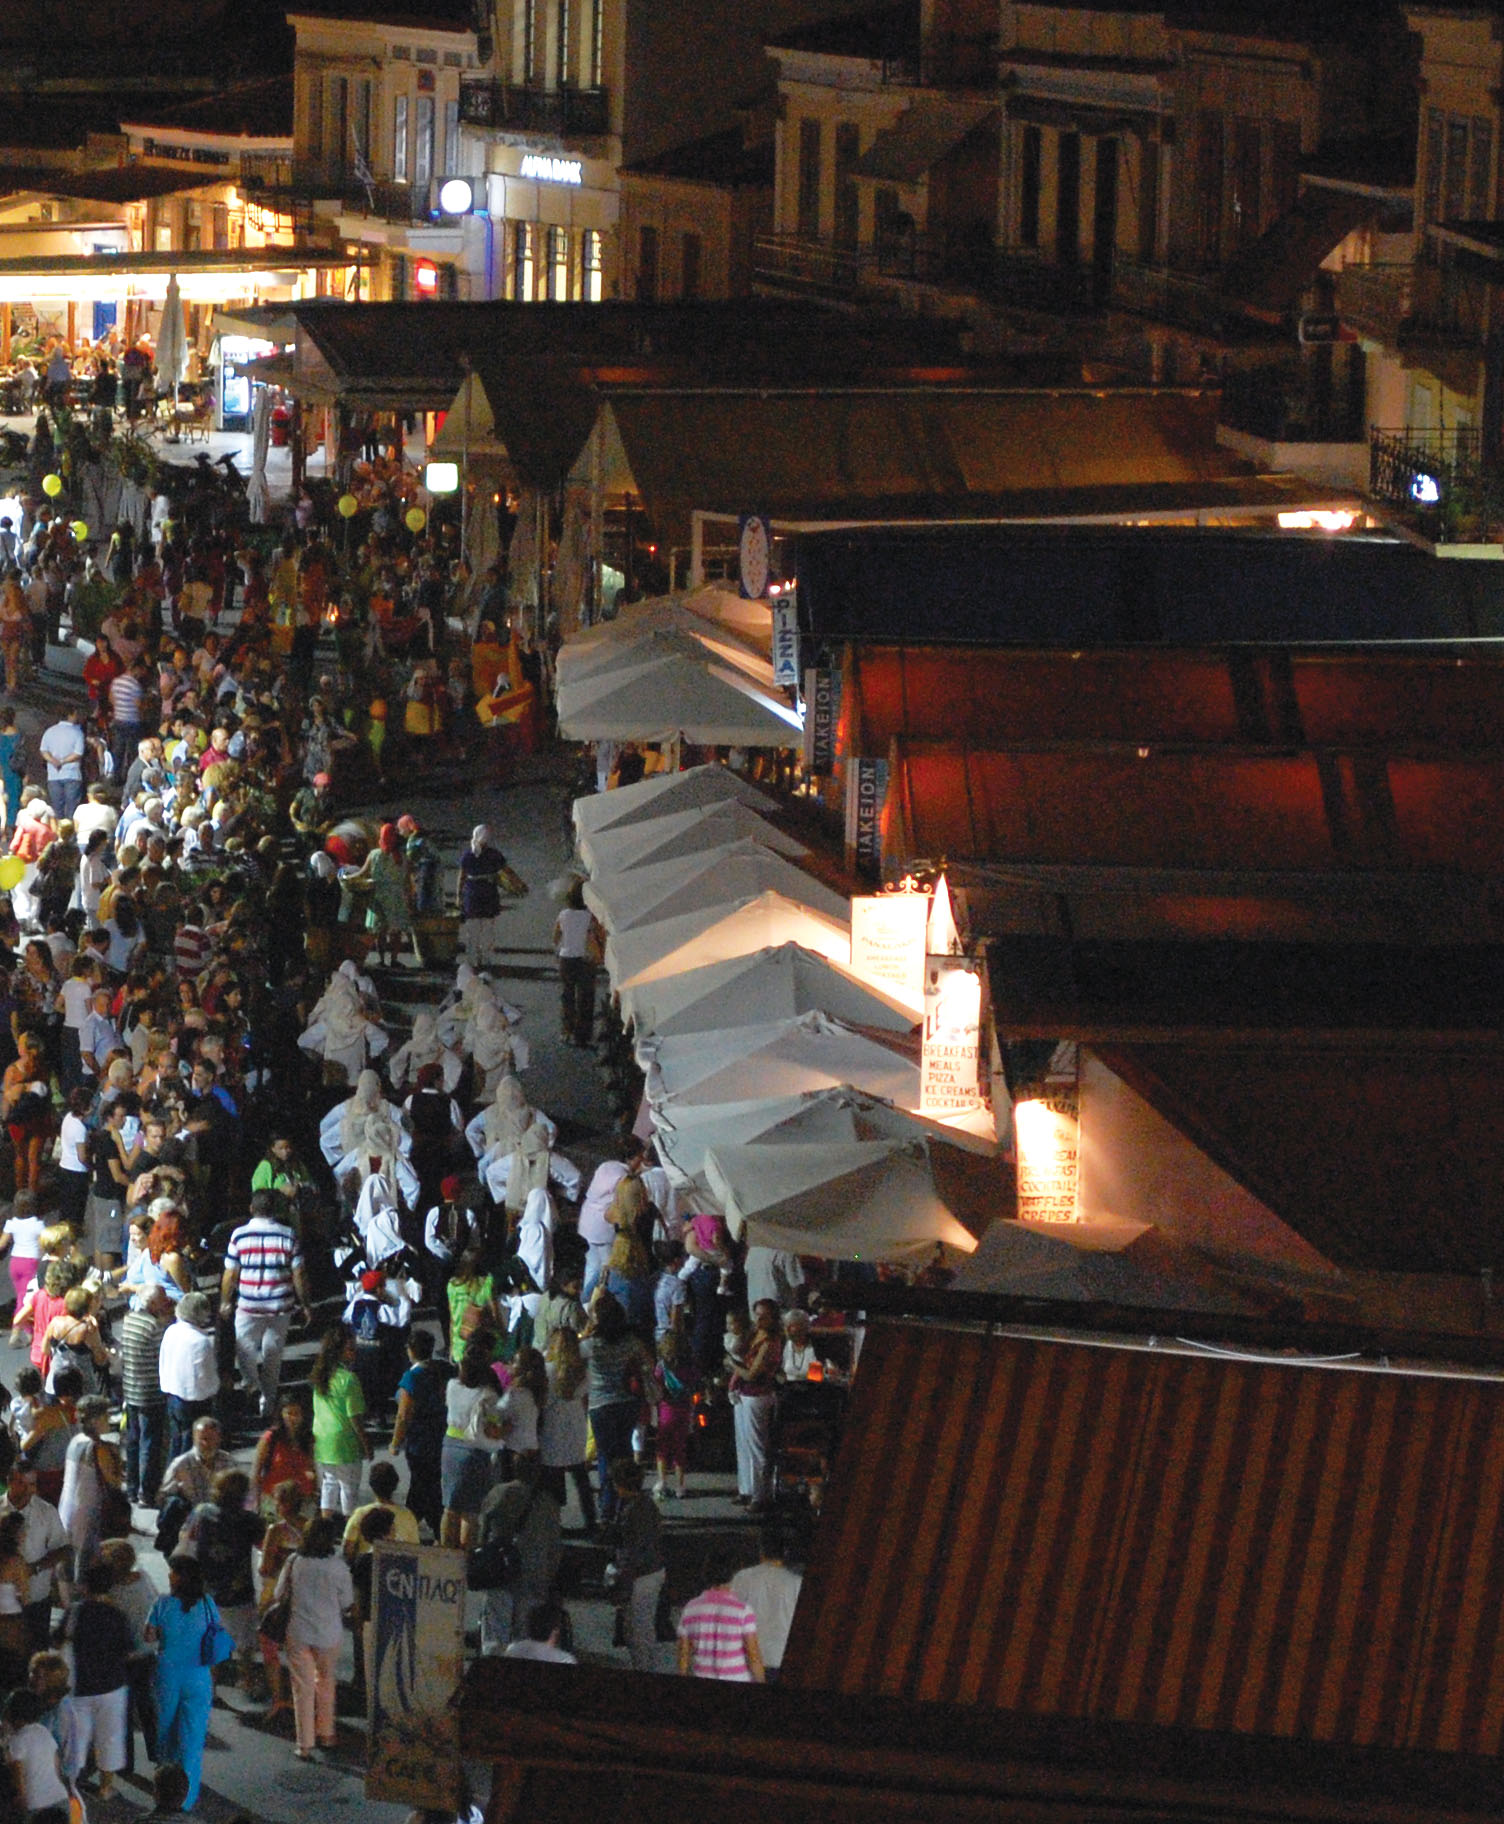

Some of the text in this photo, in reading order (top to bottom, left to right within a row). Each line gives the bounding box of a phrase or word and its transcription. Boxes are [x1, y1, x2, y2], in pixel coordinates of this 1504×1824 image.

[776, 599, 795, 673] PIZZA
[923, 1043, 979, 1059] BREAKFAST
[929, 1060, 961, 1072] MEALS
[928, 1072, 956, 1084] PIZZA
[940, 1086, 977, 1098] CREAMS
[1021, 1210, 1072, 1222] CREPES
